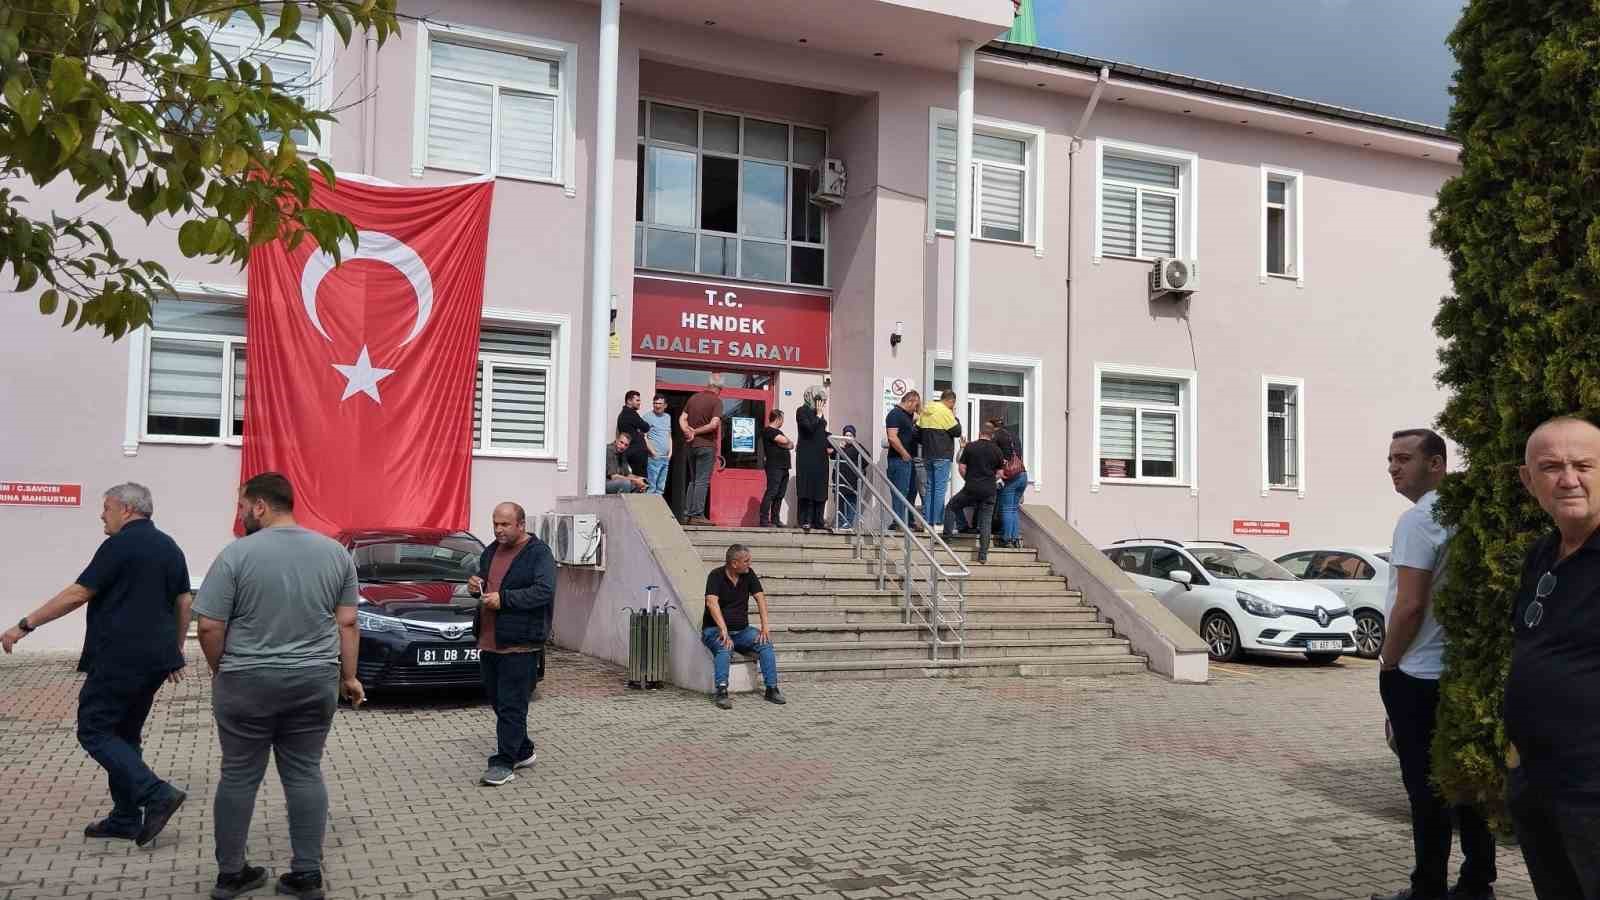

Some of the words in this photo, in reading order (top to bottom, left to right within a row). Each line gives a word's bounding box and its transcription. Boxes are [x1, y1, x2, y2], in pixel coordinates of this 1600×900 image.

[705, 289, 743, 308] T.C.
[681, 312, 766, 335] HENDEK
[639, 334, 723, 355] ADALET
[728, 341, 801, 362] SARAYI
[21, 495, 77, 503] MAHSUSTUR
[424, 650, 436, 661] 81
[444, 649, 458, 661] DB
